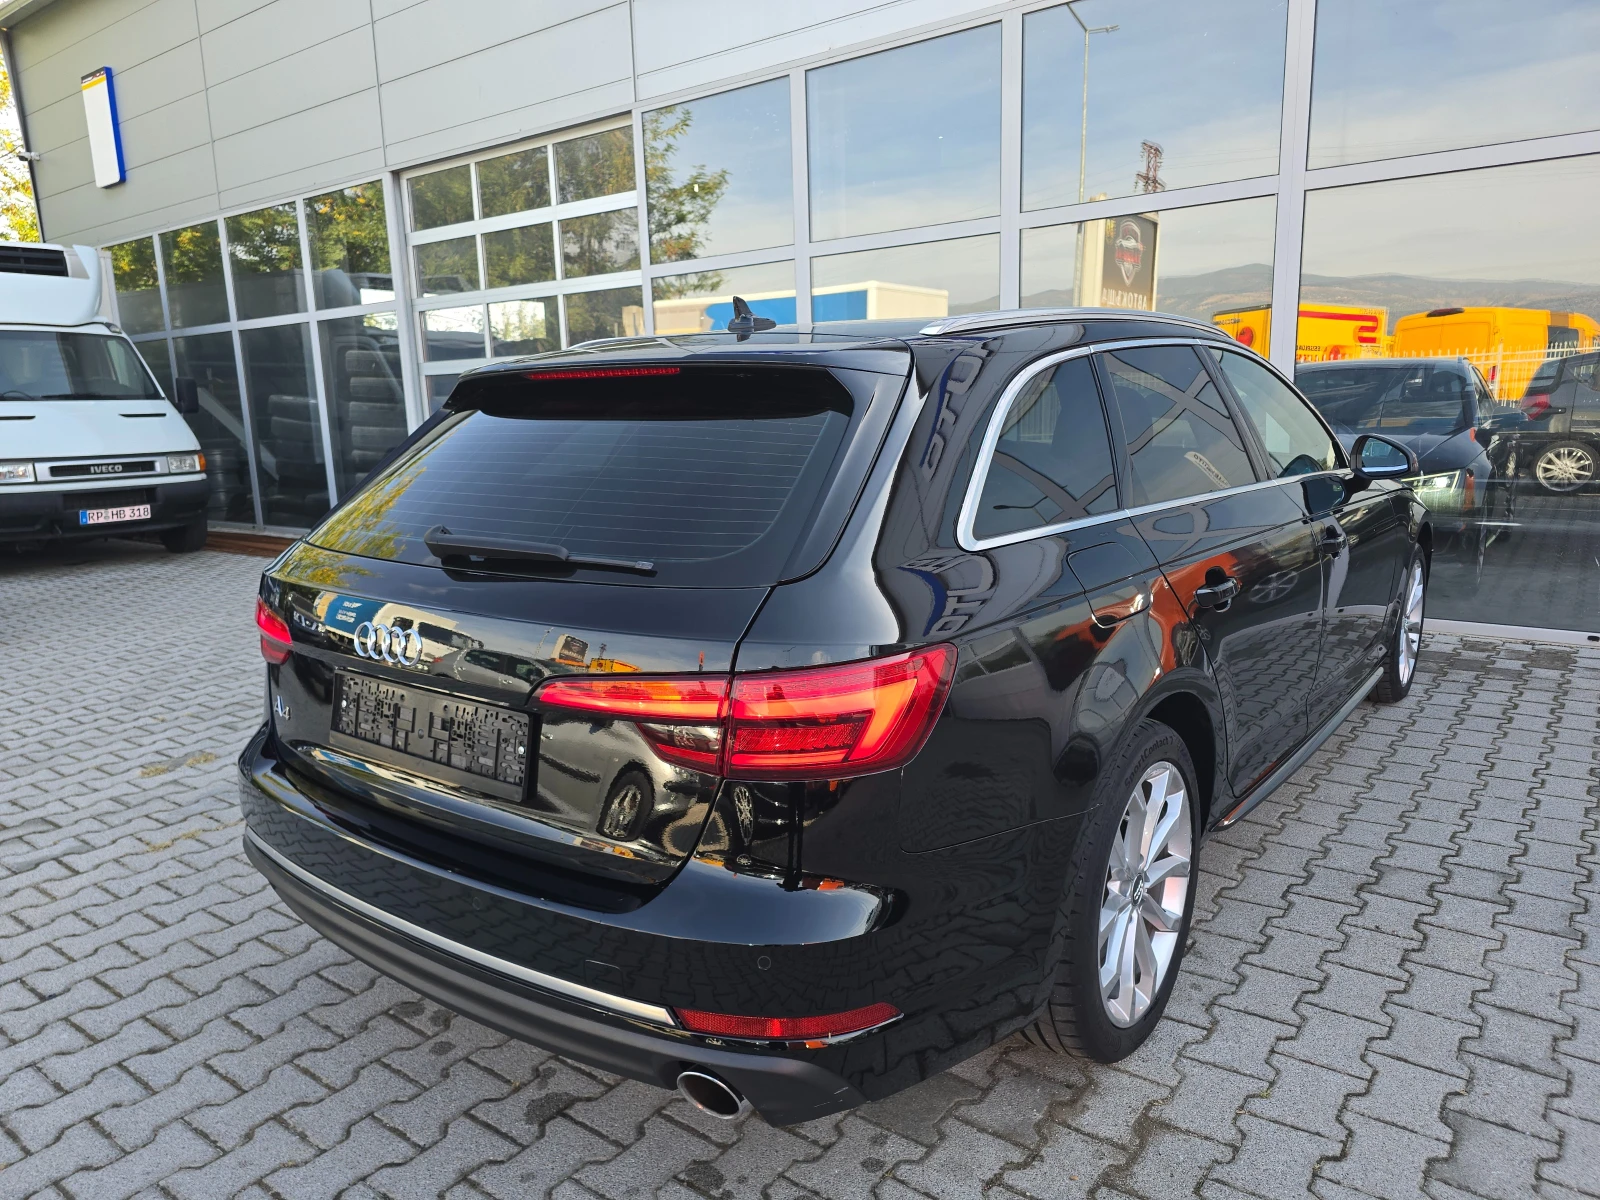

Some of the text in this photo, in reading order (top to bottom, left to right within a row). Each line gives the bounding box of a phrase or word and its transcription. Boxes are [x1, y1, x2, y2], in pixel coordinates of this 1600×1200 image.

[90, 464, 123, 474] IVECO
[88, 507, 150, 521] RP HB 318
[273, 695, 292, 721] A4
[1124, 736, 1169, 789] SportContact
